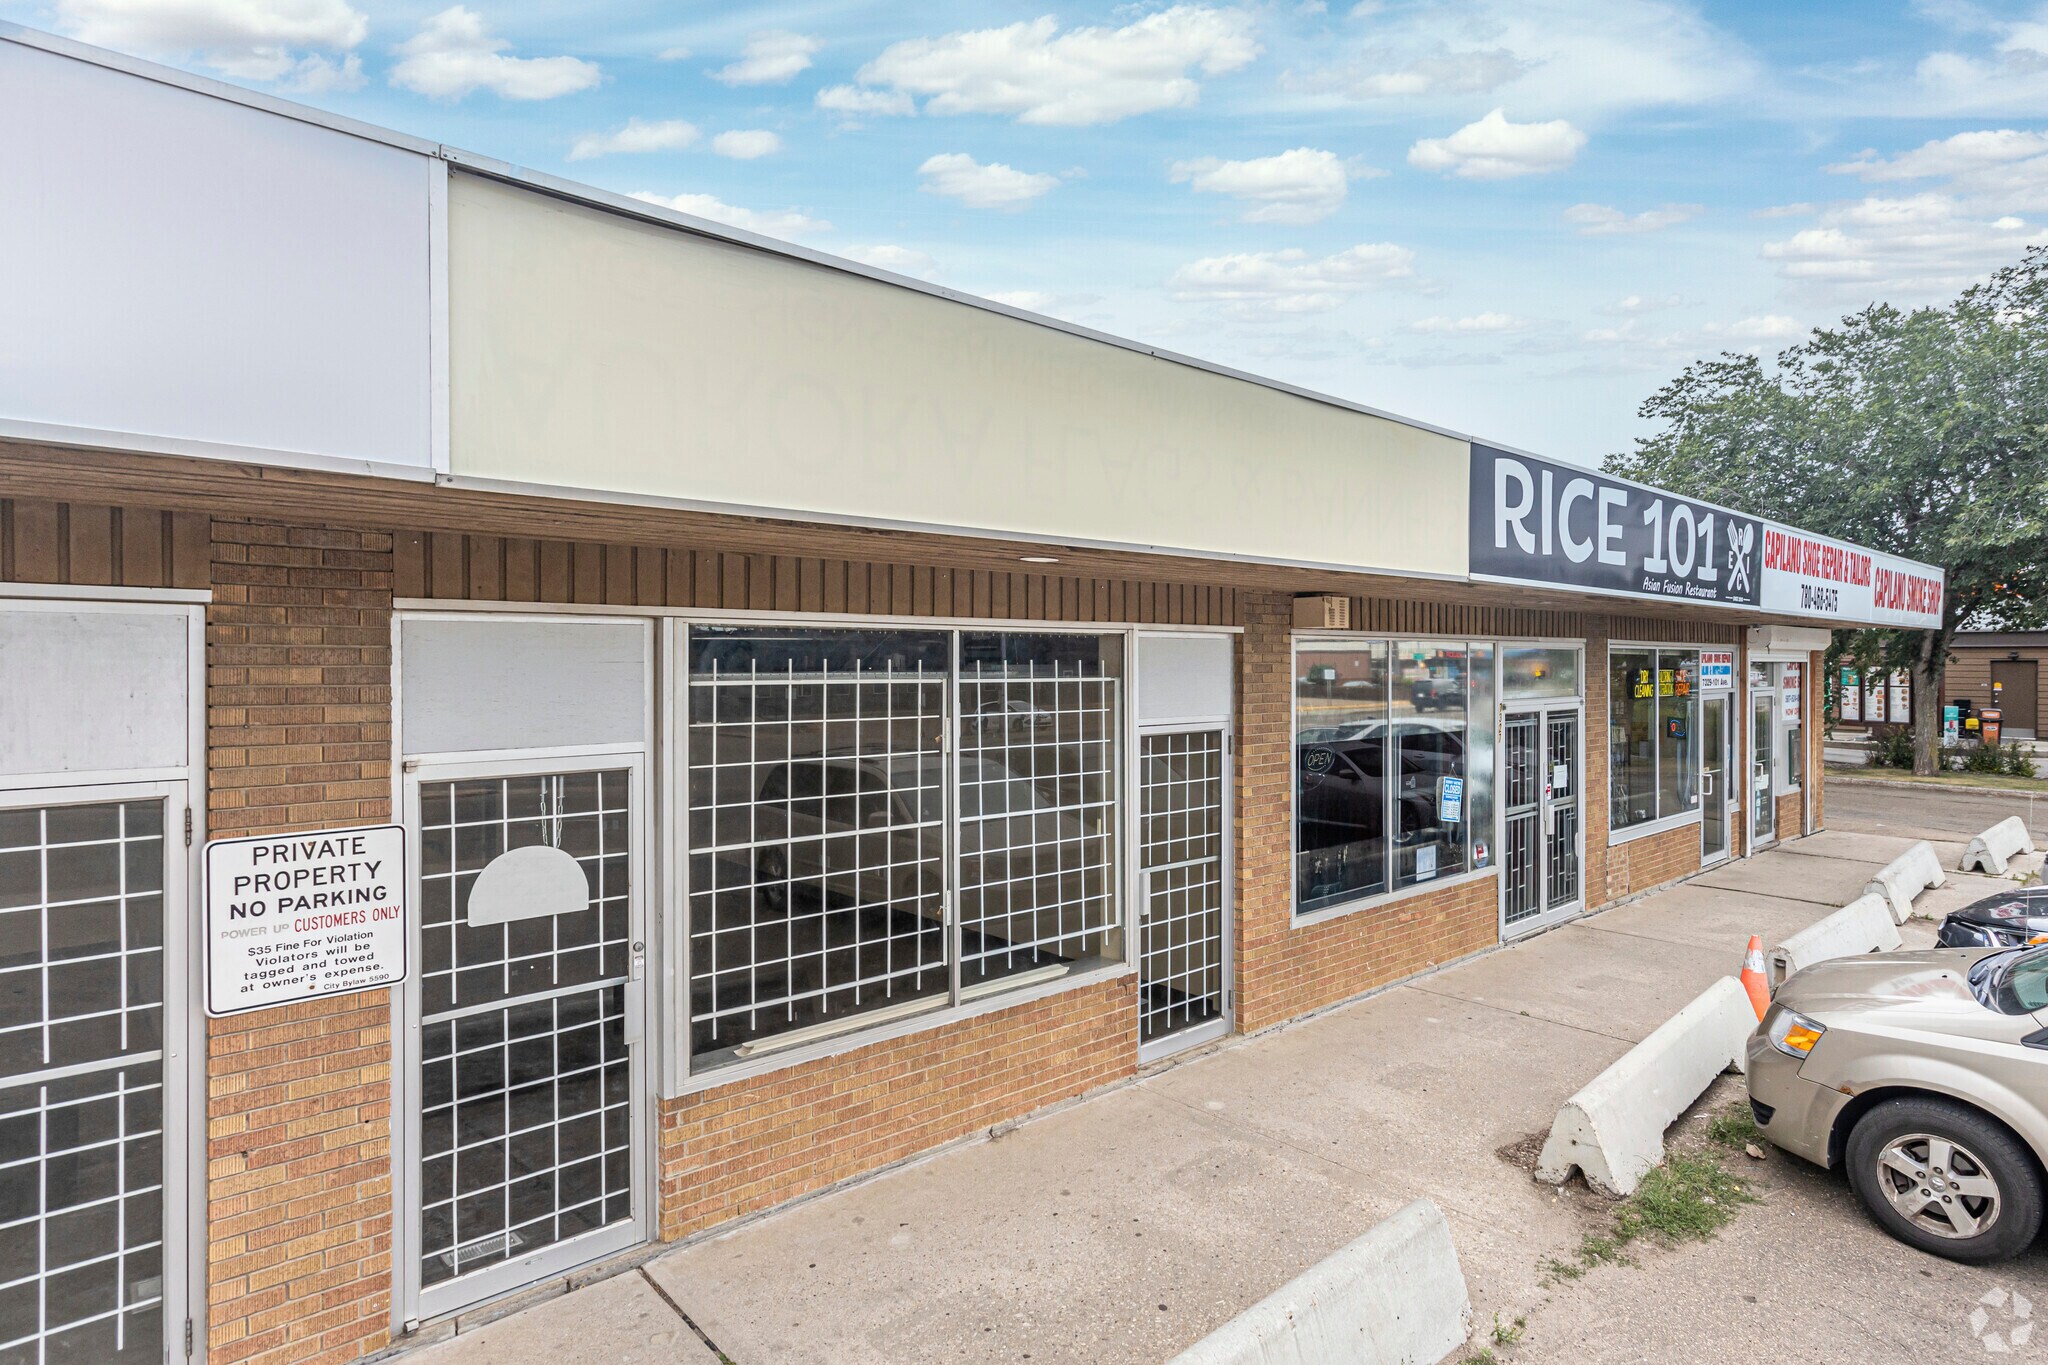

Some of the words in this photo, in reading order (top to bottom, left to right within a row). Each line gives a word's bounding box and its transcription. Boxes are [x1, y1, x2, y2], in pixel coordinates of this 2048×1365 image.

[1494, 458, 1628, 566] RICE
[1643, 499, 1718, 581] 101
[1765, 529, 1802, 574] CAPILANO
[1802, 540, 1821, 577] SHOE
[1821, 545, 1843, 582] REPAIR
[1843, 551, 1849, 583] &
[1849, 552, 1872, 587] TAILORS
[1642, 576, 1661, 592] Asian
[1663, 579, 1683, 594] Fusion
[1685, 583, 1718, 599] Restaurant
[1800, 584, 1838, 612] 780-468-5475
[1874, 567, 1906, 611] CAPILANO
[1906, 575, 1927, 613] SMOKE
[1927, 579, 1942, 615] SHOP
[1634, 684, 1654, 698] CLEANING
[1307, 752, 1332, 767] OPEN
[1444, 783, 1461, 795] CLOSED
[253, 836, 366, 866] PRIVATE
[233, 860, 382, 896] PROPERTY
[230, 901, 266, 920] NO
[278, 885, 387, 914] PARKING
[221, 926, 267, 940] POWER
[273, 923, 290, 934] UP
[294, 910, 366, 933] CUSTOMERS
[372, 905, 401, 922] ONLY
[247, 945, 272, 957] $35
[275, 942, 300, 953] Fine
[303, 938, 322, 948] For
[326, 931, 374, 945] Violation
[255, 951, 318, 967] Violators
[325, 945, 347, 956] will
[354, 942, 371, 952] be
[240, 984, 255, 993] at
[262, 973, 317, 990] owner's
[324, 963, 384, 979] expense.
[244, 965, 294, 981] tagged
[302, 960, 327, 971] and
[334, 952, 374, 966] towed
[323, 982, 340, 991] City
[342, 977, 367, 988] Bylaw
[369, 973, 390, 983] 5590
